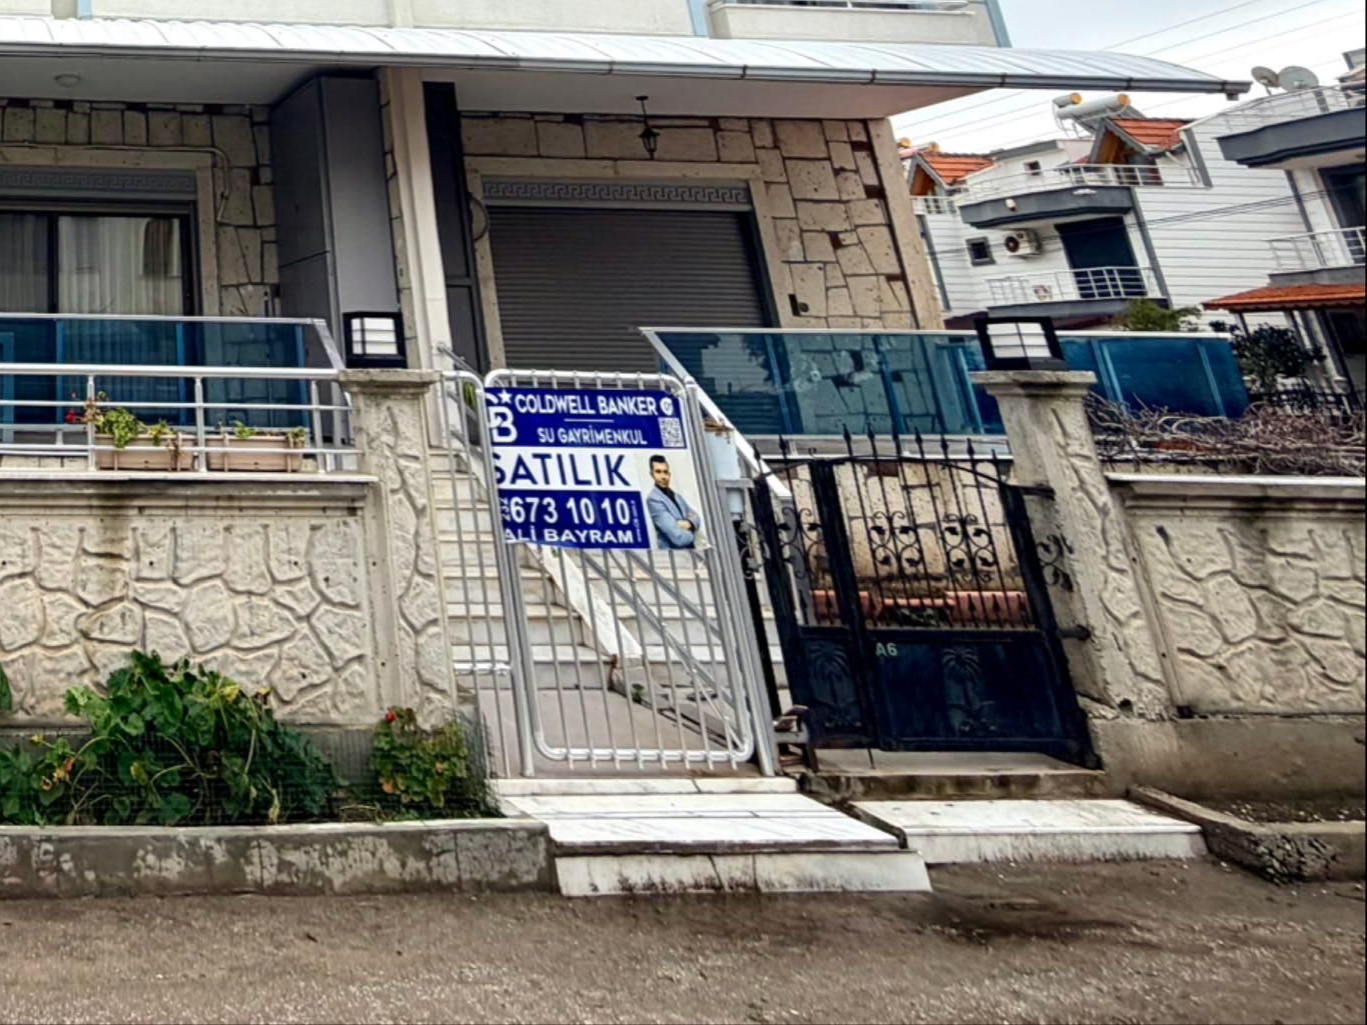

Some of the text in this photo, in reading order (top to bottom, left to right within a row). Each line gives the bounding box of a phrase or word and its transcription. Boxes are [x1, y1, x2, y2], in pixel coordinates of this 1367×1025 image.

[515, 393, 659, 416] COLDWELL BANKER
[537, 424, 648, 445] SU GAYRİMENKUL
[492, 452, 632, 487] SATILIK
[510, 495, 559, 524] 673
[566, 496, 595, 525] 10
[601, 497, 630, 525] 10
[543, 528, 634, 544] BAYRAM
[875, 642, 898, 657] A6
